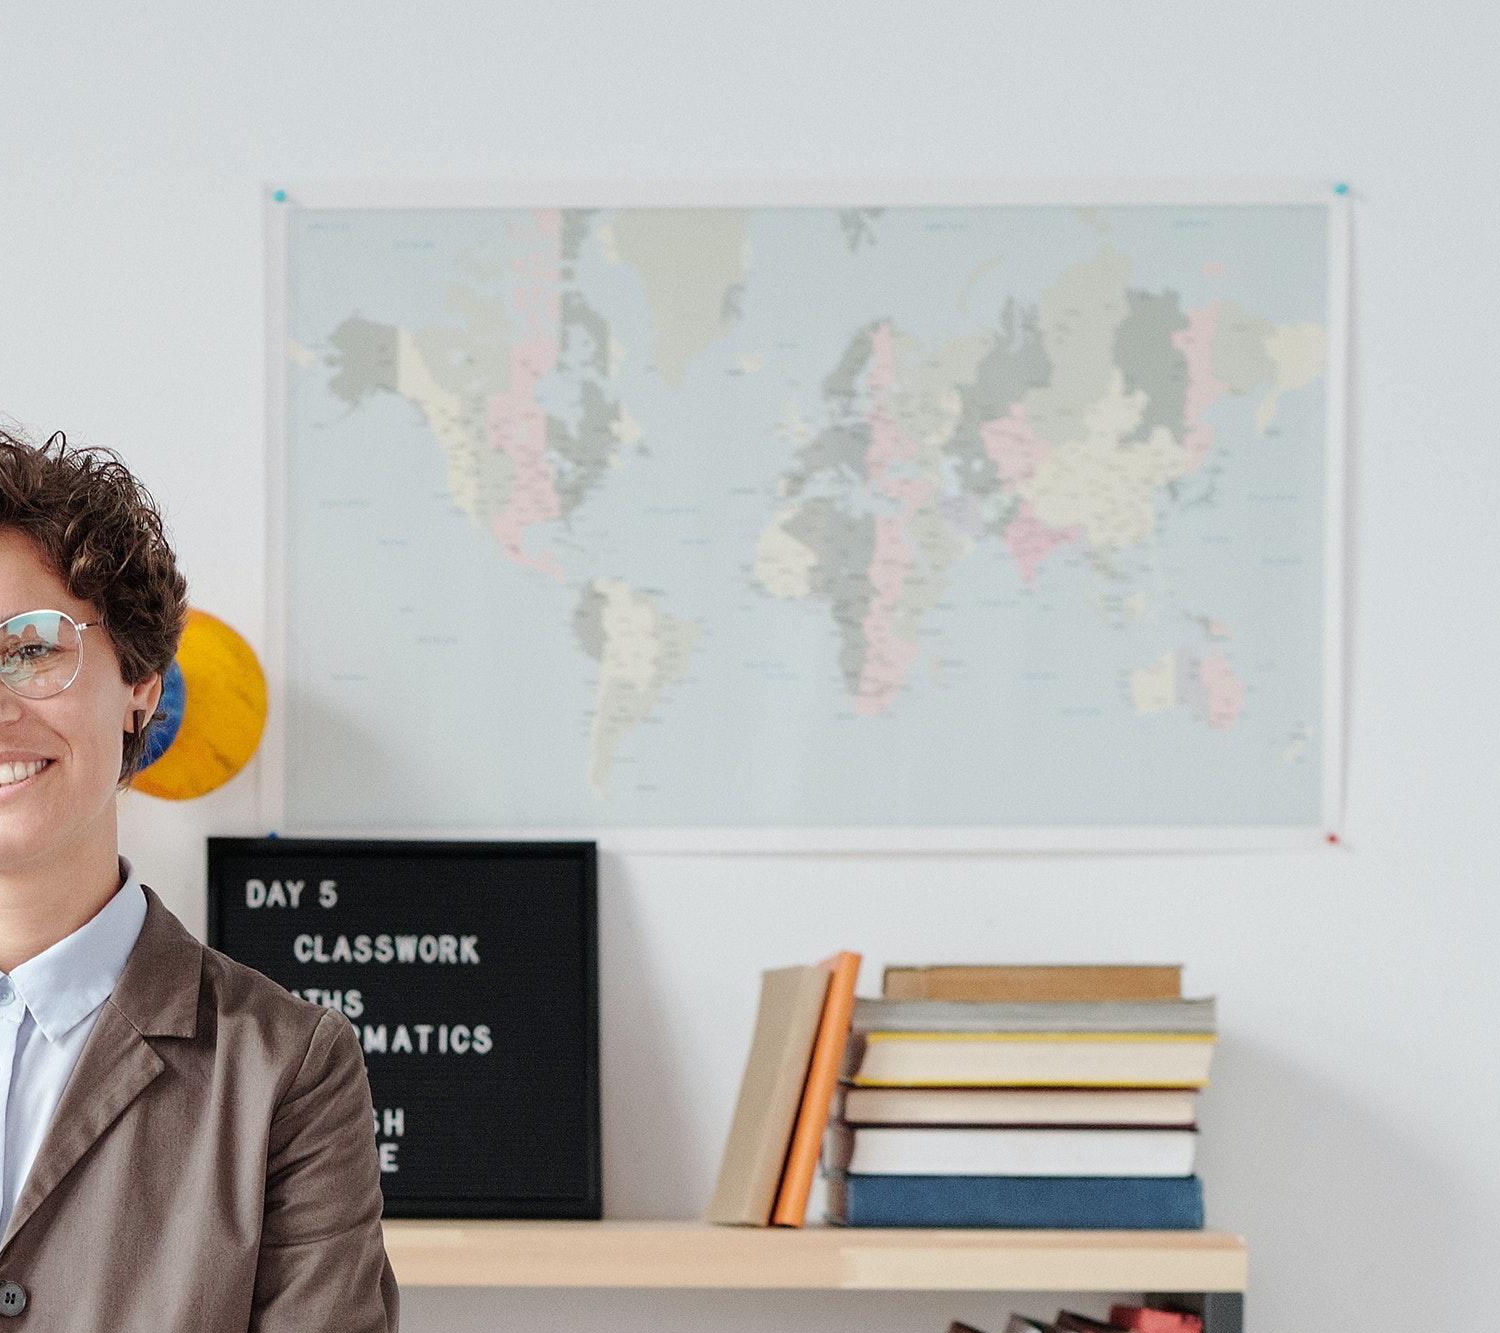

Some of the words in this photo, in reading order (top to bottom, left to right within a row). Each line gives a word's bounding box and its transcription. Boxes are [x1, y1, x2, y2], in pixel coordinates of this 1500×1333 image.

[246, 879, 304, 909] DAY
[319, 880, 338, 909] 5
[293, 934, 481, 964] CLASSWORK
[290, 988, 364, 1018] THS
[351, 1024, 494, 1054] MATICS
